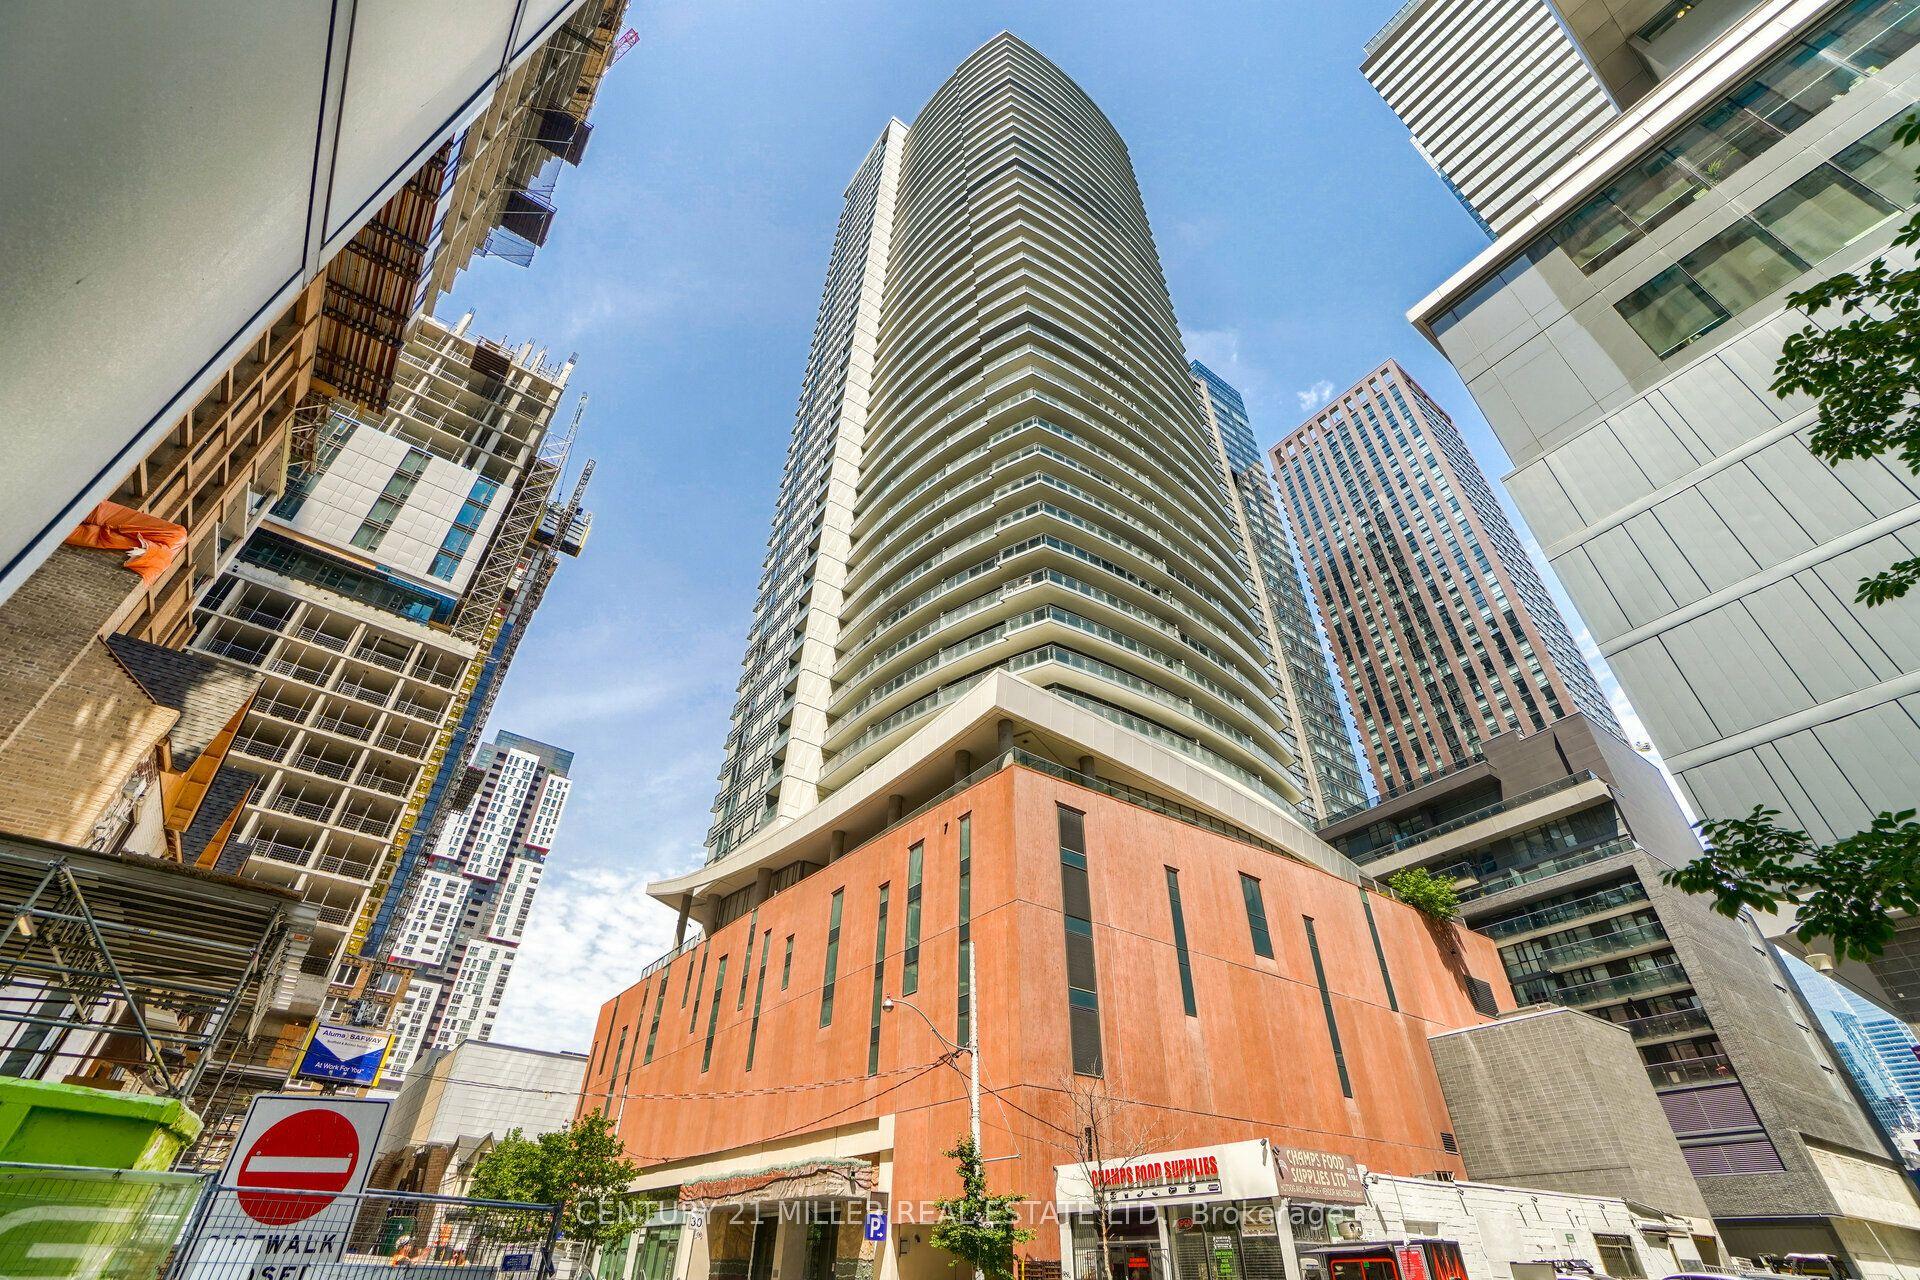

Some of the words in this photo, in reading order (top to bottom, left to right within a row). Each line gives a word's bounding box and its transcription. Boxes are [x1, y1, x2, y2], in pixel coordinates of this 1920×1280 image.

[322, 1030, 346, 1039] Aluma
[349, 1034, 382, 1044] SAFWAY
[323, 1062, 339, 1071] Work
[339, 1064, 350, 1072] For
[1134, 1162, 1161, 1182] FOOD
[1163, 1155, 1218, 1179] SUPPLIES
[1286, 1149, 1321, 1168] CHAMPS
[1321, 1154, 1344, 1170] FOOD
[1291, 1167, 1331, 1185] SUPPLIES
[1331, 1171, 1349, 1188] LTD.
[691, 1217, 703, 1228] 30
[870, 1217, 881, 1238] P
